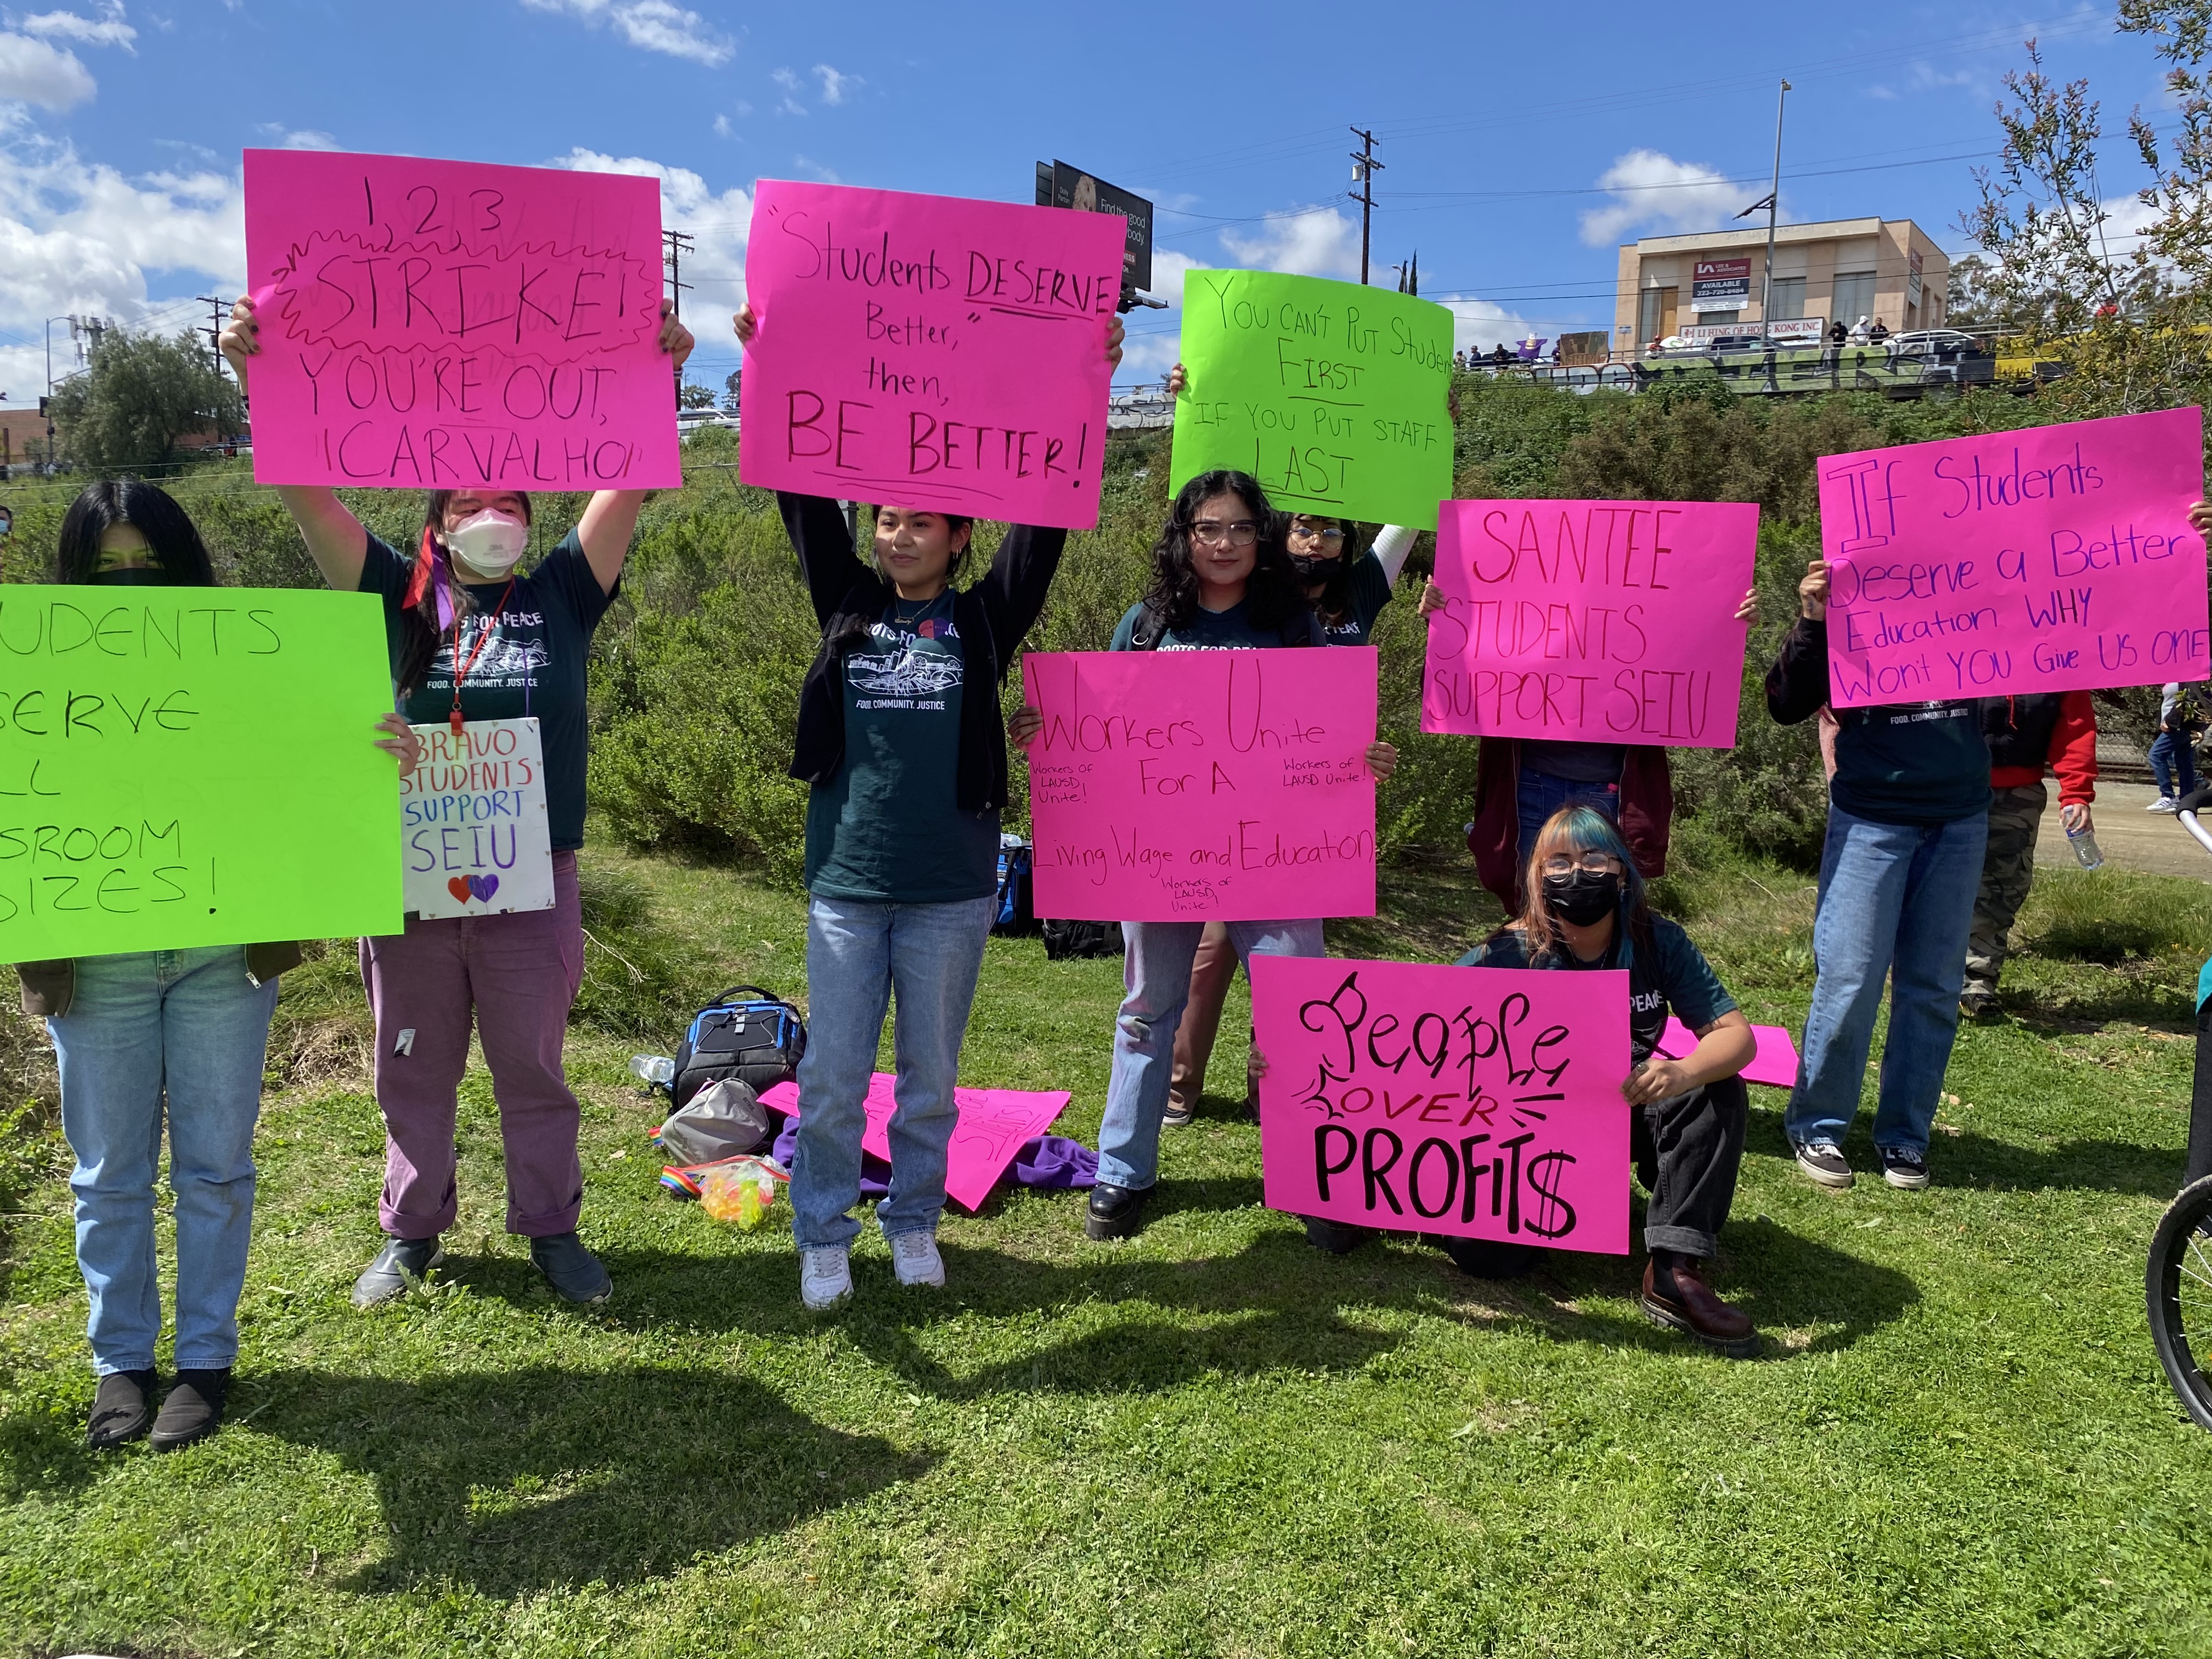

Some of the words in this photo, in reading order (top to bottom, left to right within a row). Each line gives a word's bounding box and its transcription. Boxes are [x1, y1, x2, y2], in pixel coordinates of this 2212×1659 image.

[469, 189, 504, 231] 3
[1059, 187, 1069, 197] Dolly
[1101, 198, 1115, 215] Find
[1128, 213, 1146, 228] good
[317, 255, 625, 345] STRIKE!
[967, 250, 1114, 315] DESERVE
[1701, 280, 1741, 289] AVAILABLE
[1205, 276, 1269, 329] YOU
[1280, 303, 1330, 338] CAN'T
[1348, 307, 1379, 354] PUT
[1708, 328, 1730, 337] HING
[1733, 326, 1744, 335] OF
[1774, 323, 1799, 332] KONG
[1802, 321, 1820, 331] INC.
[862, 357, 949, 407] then,
[1278, 337, 1365, 390] FIRST
[299, 352, 482, 415] YOU'RE
[503, 364, 616, 426] OUT,
[786, 390, 874, 471] BE
[908, 411, 1087, 488] BETTER!
[1194, 402, 1229, 427] IF
[1245, 403, 1295, 431] YOU
[1314, 408, 1353, 438] PUT
[1374, 420, 1437, 452] STAFF
[1255, 438, 1354, 493] LAST
[1827, 459, 1906, 553] If
[1934, 442, 2103, 518] Students
[1473, 509, 1681, 590] SANTEE
[1828, 557, 1978, 608] Deserve
[2051, 524, 2186, 578] Better
[502, 611, 544, 628] PEACE
[1435, 597, 1646, 664] STUDENTS
[1847, 606, 1997, 652] Education
[2025, 586, 2092, 628] WHY
[427, 680, 450, 689] FOOD.
[506, 678, 538, 687] JUSTCE
[1948, 648, 2012, 690] YOU
[2034, 643, 2079, 674] Give
[2098, 633, 2138, 671] US
[873, 699, 915, 709] COMMUNITY.
[916, 701, 945, 710] JUSTICE
[1031, 661, 1204, 752] Workers
[1228, 658, 1325, 753] Unite
[1428, 669, 1598, 728] SUPPORT
[1606, 669, 1711, 739] SEIU
[413, 729, 516, 763] BRAVO
[1031, 761, 1074, 774] Workers
[1284, 758, 1330, 770] Workers
[1339, 757, 1354, 768] of
[1038, 782, 1087, 804] Unite!
[1041, 776, 1080, 789] LAUSD
[1138, 758, 1196, 795] For
[1212, 761, 1236, 794] A
[1283, 774, 1319, 787] LAUSD
[1326, 764, 1365, 785] Unite!
[405, 790, 524, 826] SUPPORT
[410, 824, 516, 872] SEIU
[1031, 817, 1107, 885] Living
[1110, 825, 1173, 878] Wage
[1189, 834, 1232, 867] and
[1238, 820, 1374, 870] Education
[1161, 876, 1211, 889] Workers
[1218, 877, 1232, 886] of
[1299, 971, 1570, 1101] People
[1340, 1087, 1498, 1127] OVER
